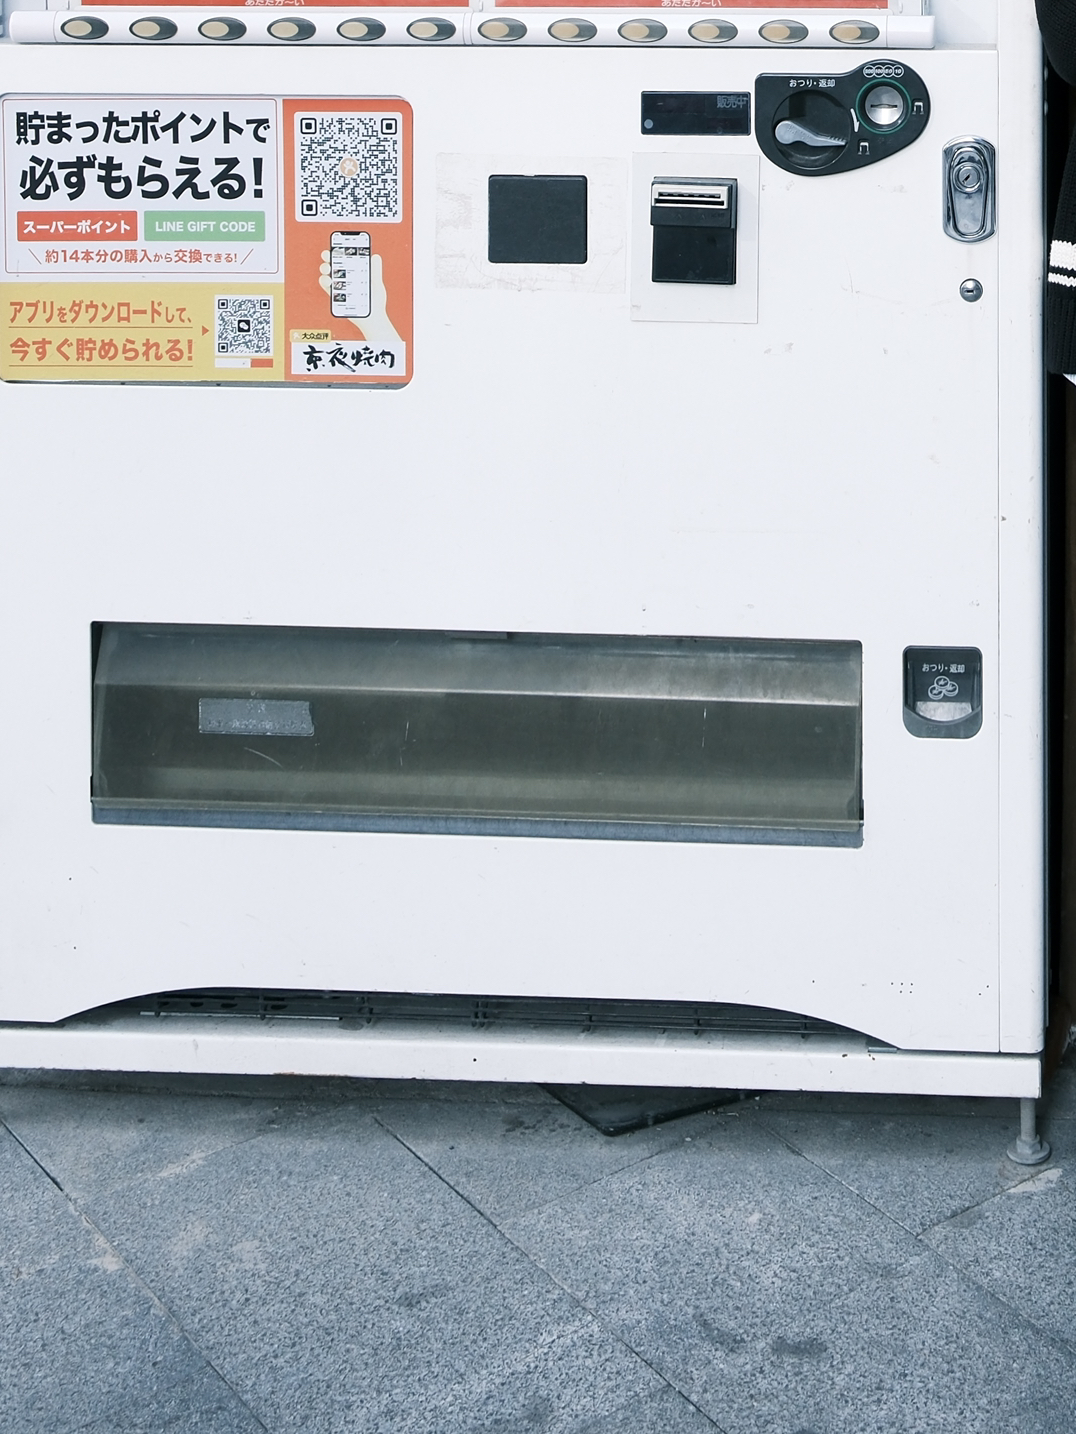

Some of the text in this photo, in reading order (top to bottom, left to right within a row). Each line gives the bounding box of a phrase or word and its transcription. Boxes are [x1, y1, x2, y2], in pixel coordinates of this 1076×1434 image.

[789, 79, 836, 89] おつり・返却
[716, 95, 748, 109] 販売中
[16, 109, 271, 147] 貯まったポイントで
[19, 154, 263, 202] 必ずもらえる!
[23, 220, 131, 235] スーパーポイント
[155, 220, 256, 233] LINE GIFT CODE
[9, 300, 192, 324] アプリをダウンロードして、
[301, 332, 329, 340] 大众点评
[9, 338, 193, 362] 今すぐ貯められる!
[921, 663, 966, 673] おつり・返却
